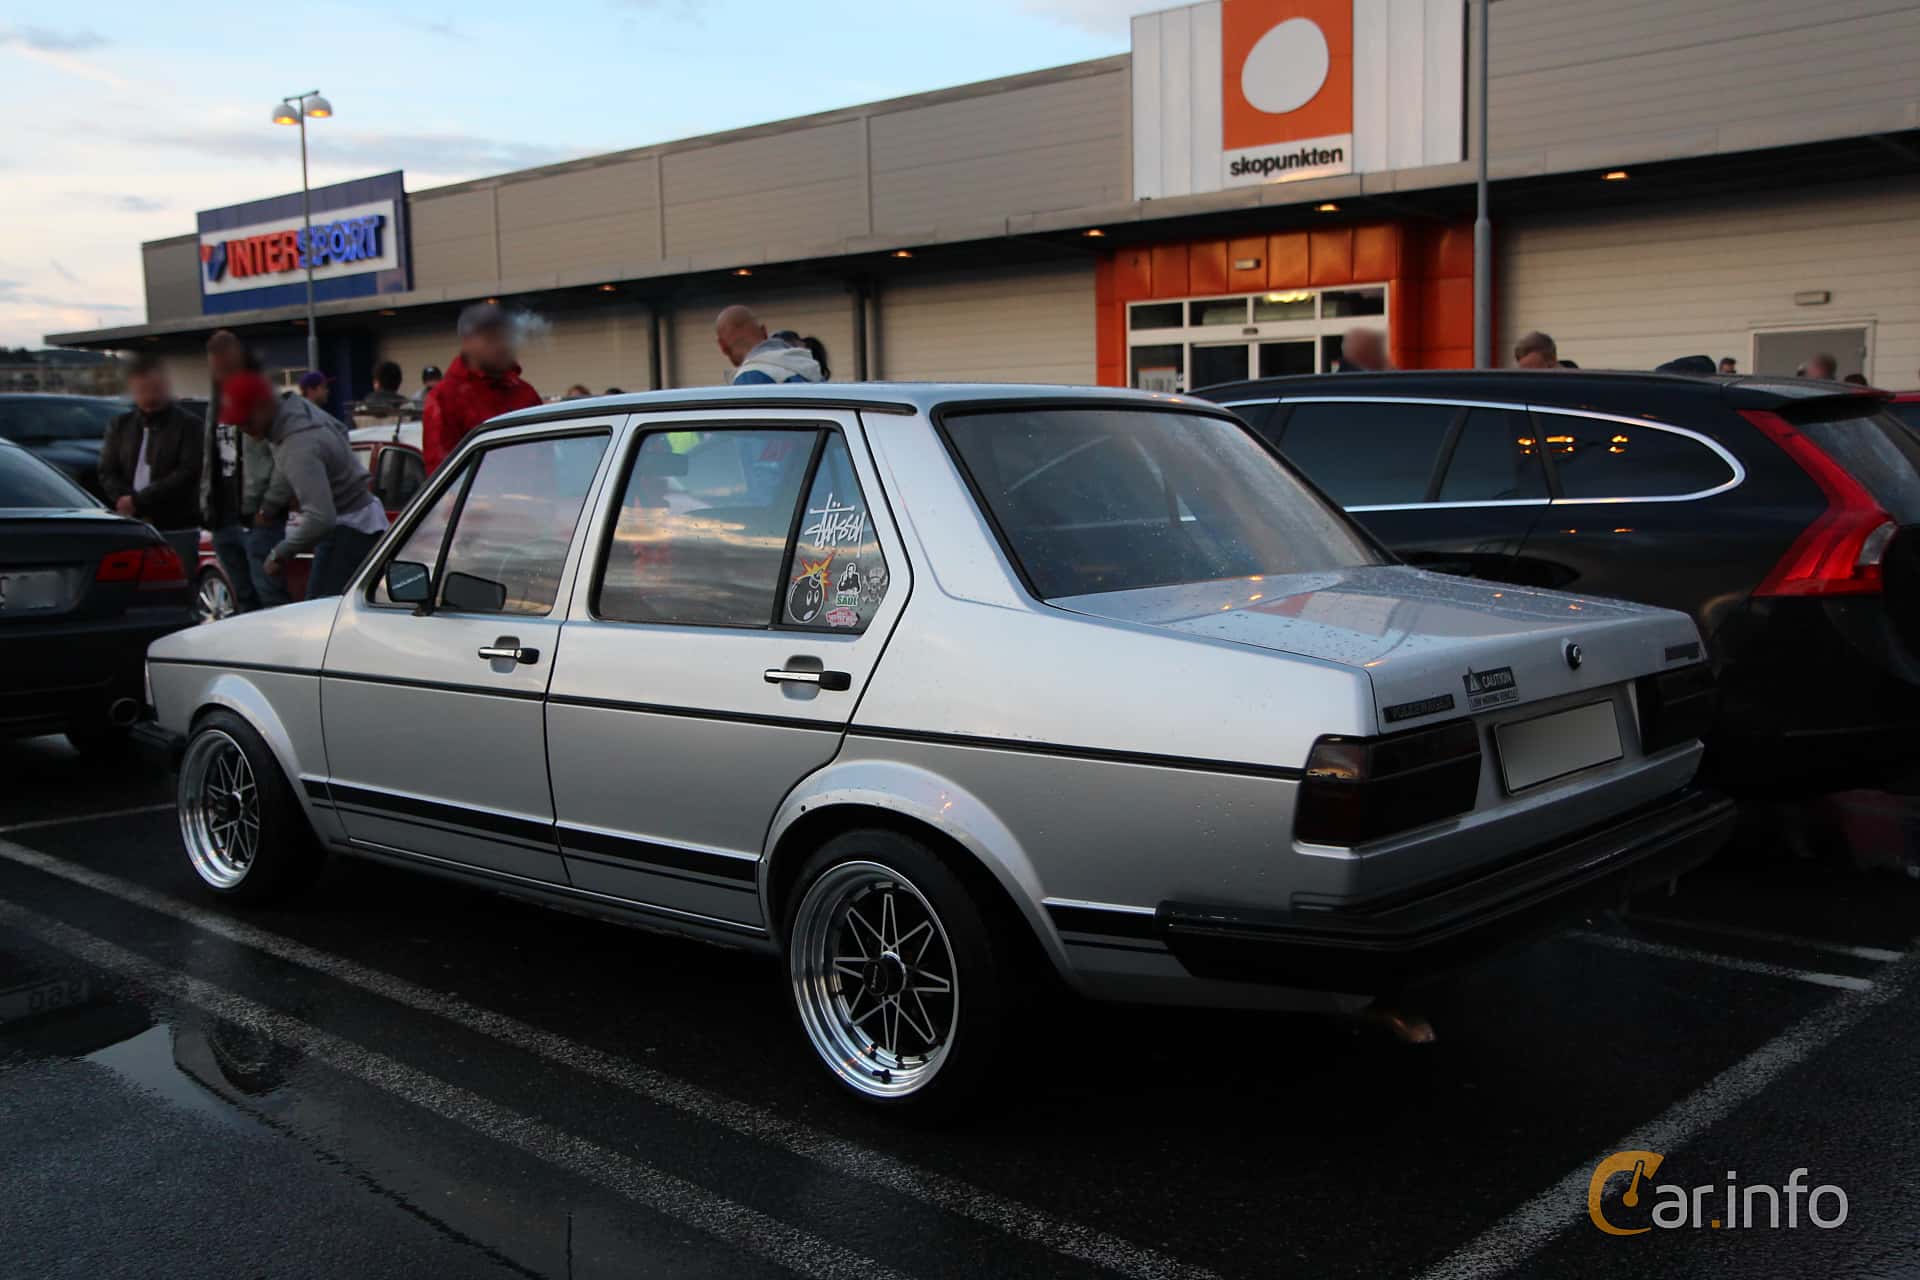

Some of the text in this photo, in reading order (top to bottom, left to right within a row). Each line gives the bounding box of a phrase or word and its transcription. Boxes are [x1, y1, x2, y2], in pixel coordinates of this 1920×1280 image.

[1230, 147, 1343, 176] skopunkten
[227, 215, 386, 278] INTERSPORT
[1481, 670, 1512, 688] CAUTION
